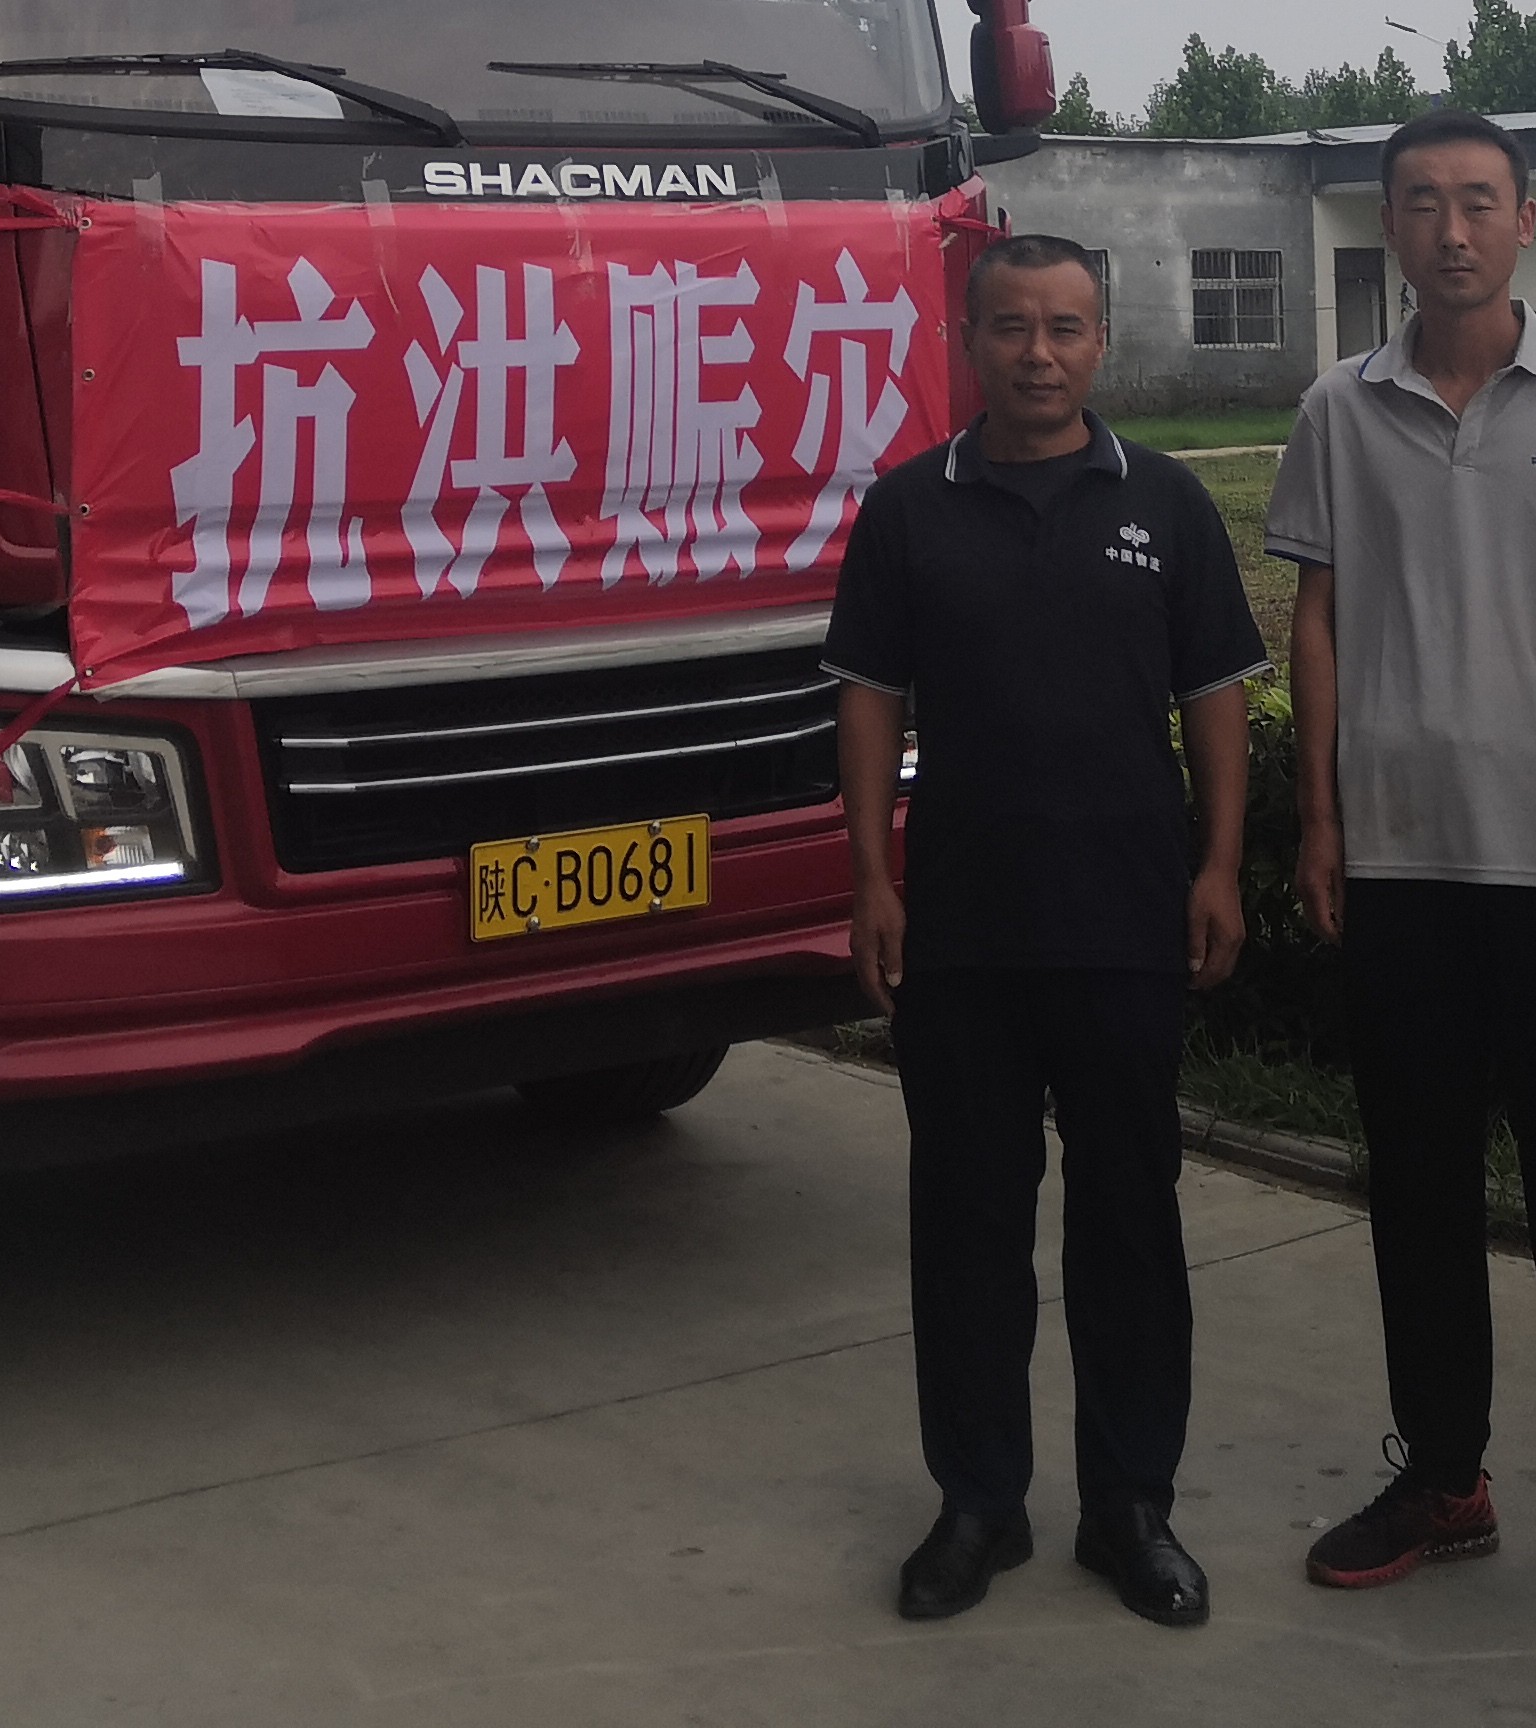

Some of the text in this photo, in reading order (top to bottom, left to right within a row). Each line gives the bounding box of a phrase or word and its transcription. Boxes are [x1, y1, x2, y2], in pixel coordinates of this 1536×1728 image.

[423, 161, 738, 198] SHACMAN
[169, 246, 919, 631] 抗洪赈灾
